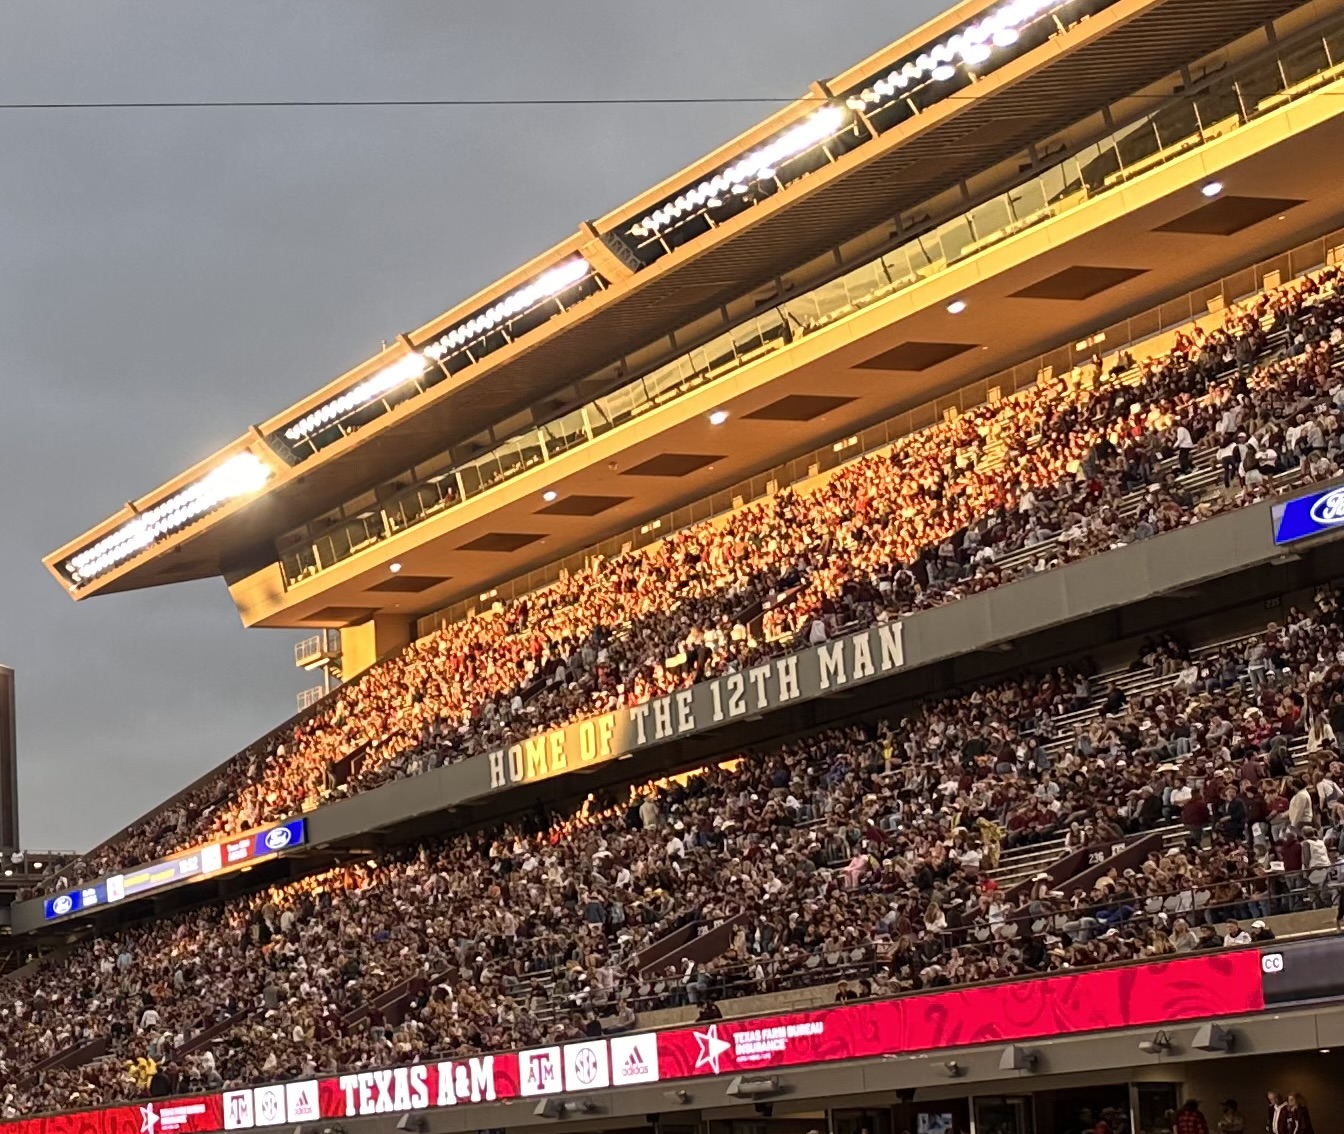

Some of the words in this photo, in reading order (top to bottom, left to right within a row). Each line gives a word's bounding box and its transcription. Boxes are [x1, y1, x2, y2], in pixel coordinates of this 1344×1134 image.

[489, 728, 569, 789] HOME
[579, 713, 615, 762] OF
[630, 689, 697, 746] THE
[711, 656, 801, 722] 12TH
[817, 621, 905, 690] MAN
[1264, 957, 1281, 970] CC
[733, 1027, 762, 1046] TEXAS
[762, 1025, 788, 1043] FARM
[788, 1021, 825, 1039] BUREAU
[621, 1061, 650, 1077] adidas
[339, 1065, 429, 1117] TEXAS
[437, 1055, 497, 1107] A&M
